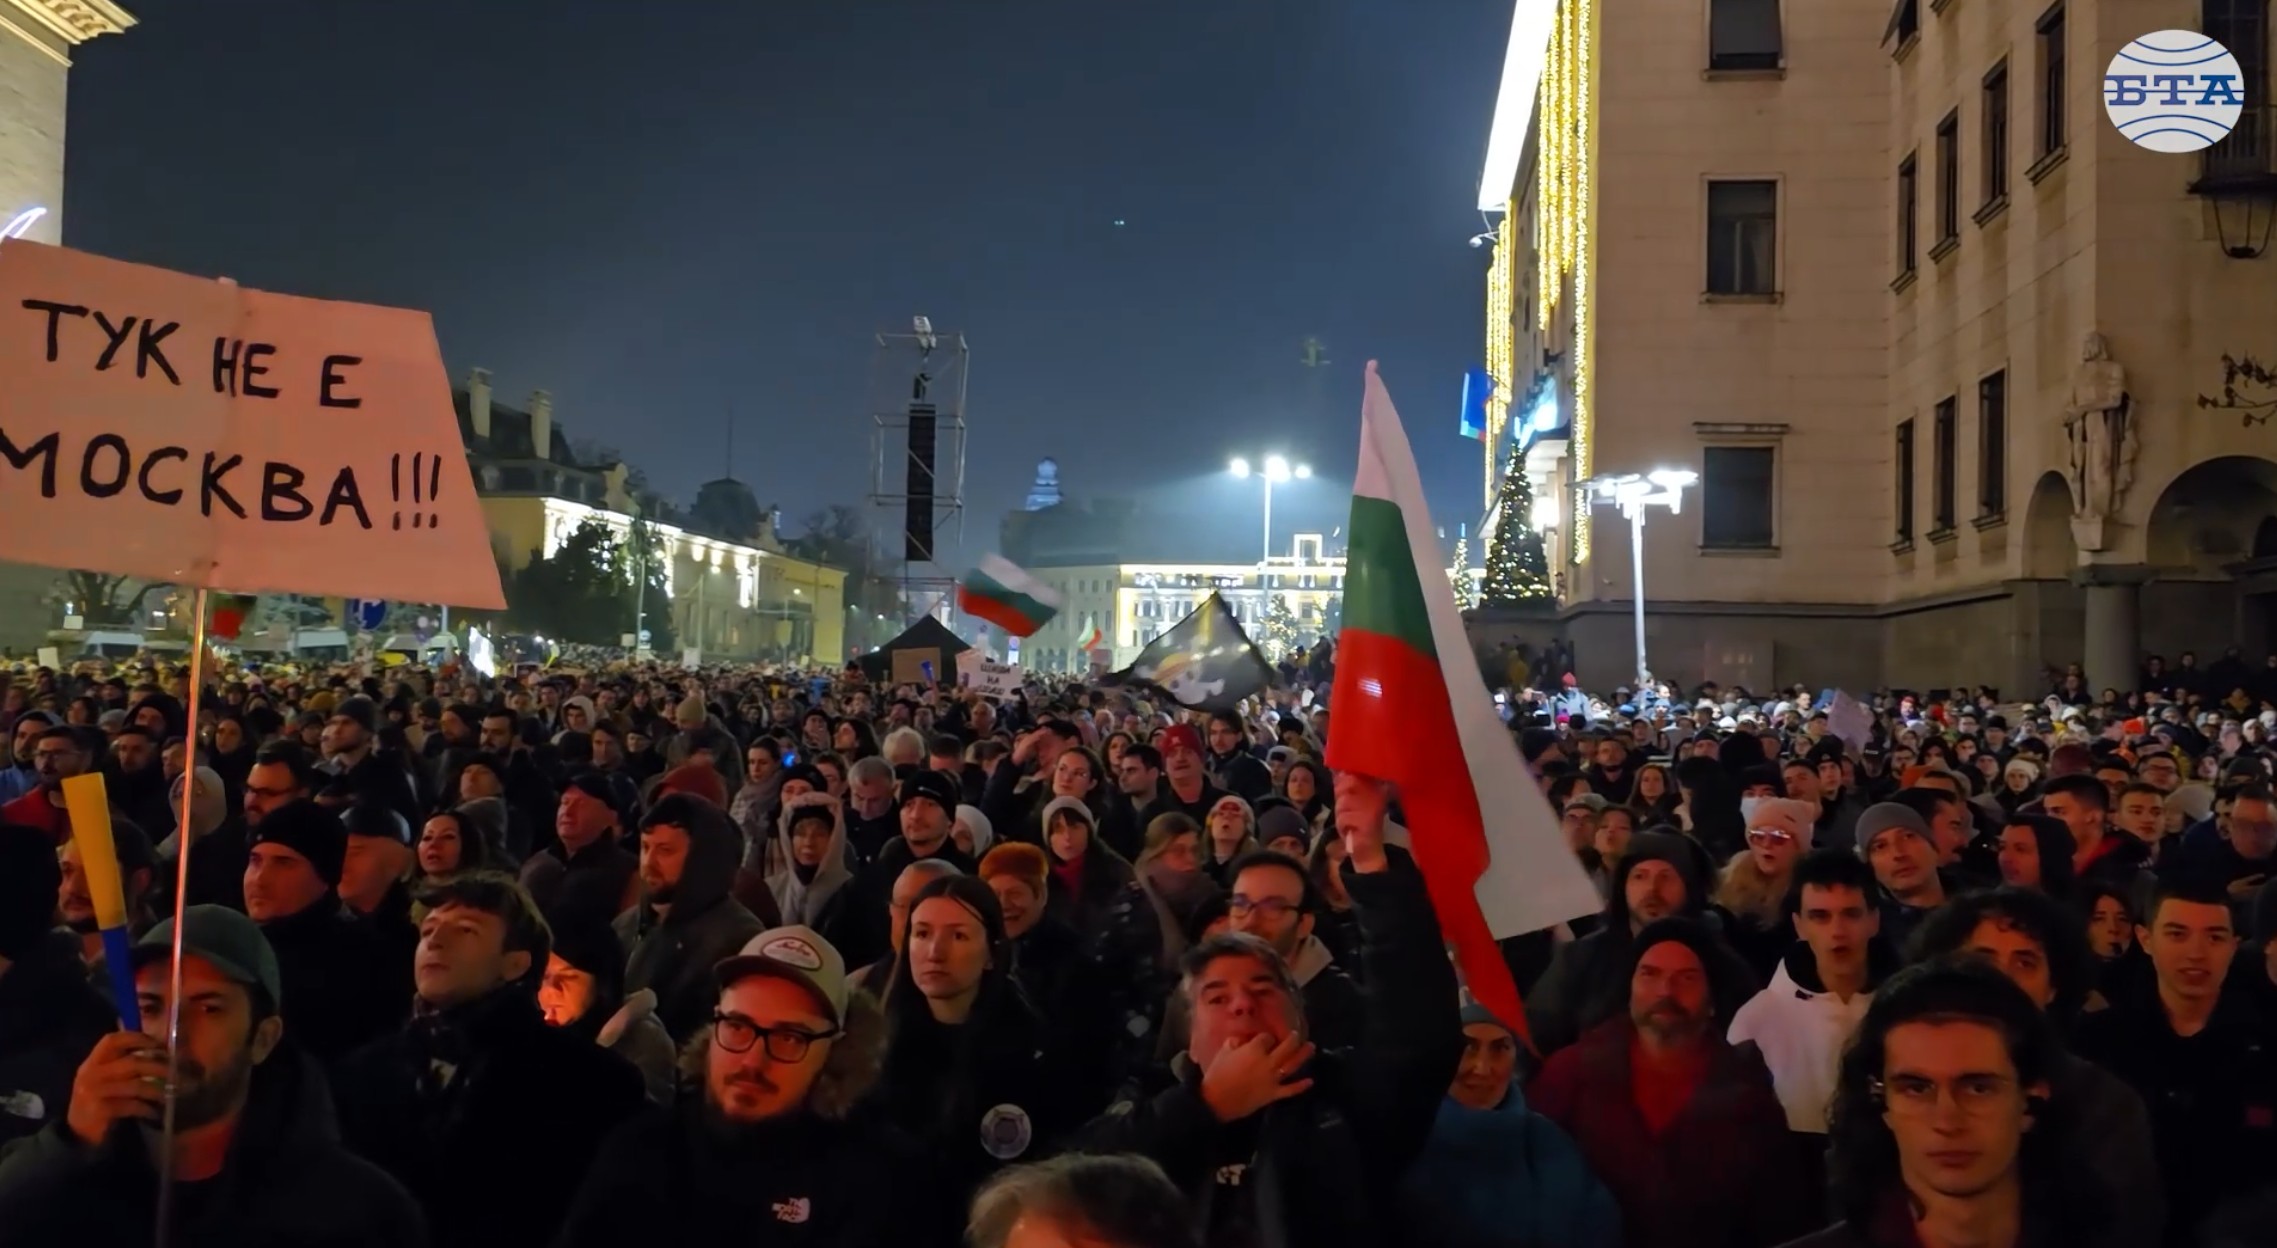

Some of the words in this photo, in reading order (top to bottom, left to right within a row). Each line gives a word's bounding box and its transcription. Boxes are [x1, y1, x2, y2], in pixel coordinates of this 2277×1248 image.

[22, 299, 180, 385] ТУК
[213, 336, 279, 399] НЕ
[320, 355, 363, 408] Е
